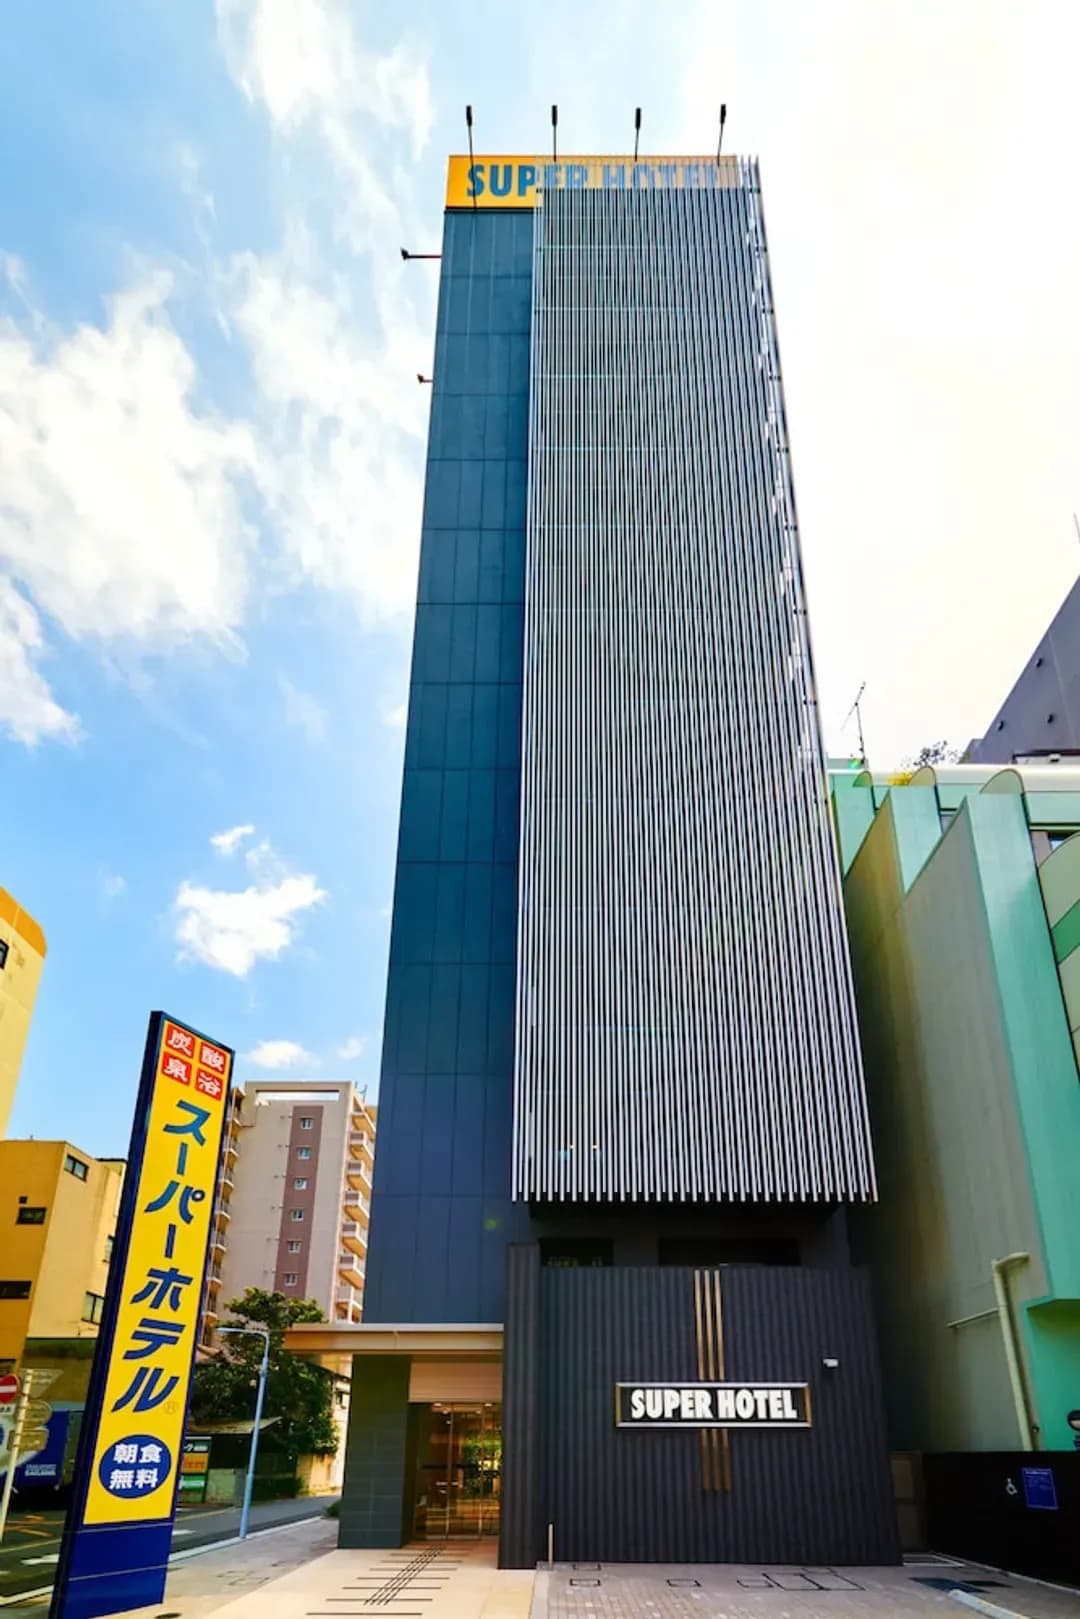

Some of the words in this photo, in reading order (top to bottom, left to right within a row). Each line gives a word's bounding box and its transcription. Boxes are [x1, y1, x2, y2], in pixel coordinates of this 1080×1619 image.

[111, 1099, 211, 1413] スーパーホテル
[631, 1389, 714, 1419] SUPER
[717, 1389, 798, 1420] HOTEL
[113, 1443, 163, 1463] 朝食
[109, 1468, 158, 1489] 無料
